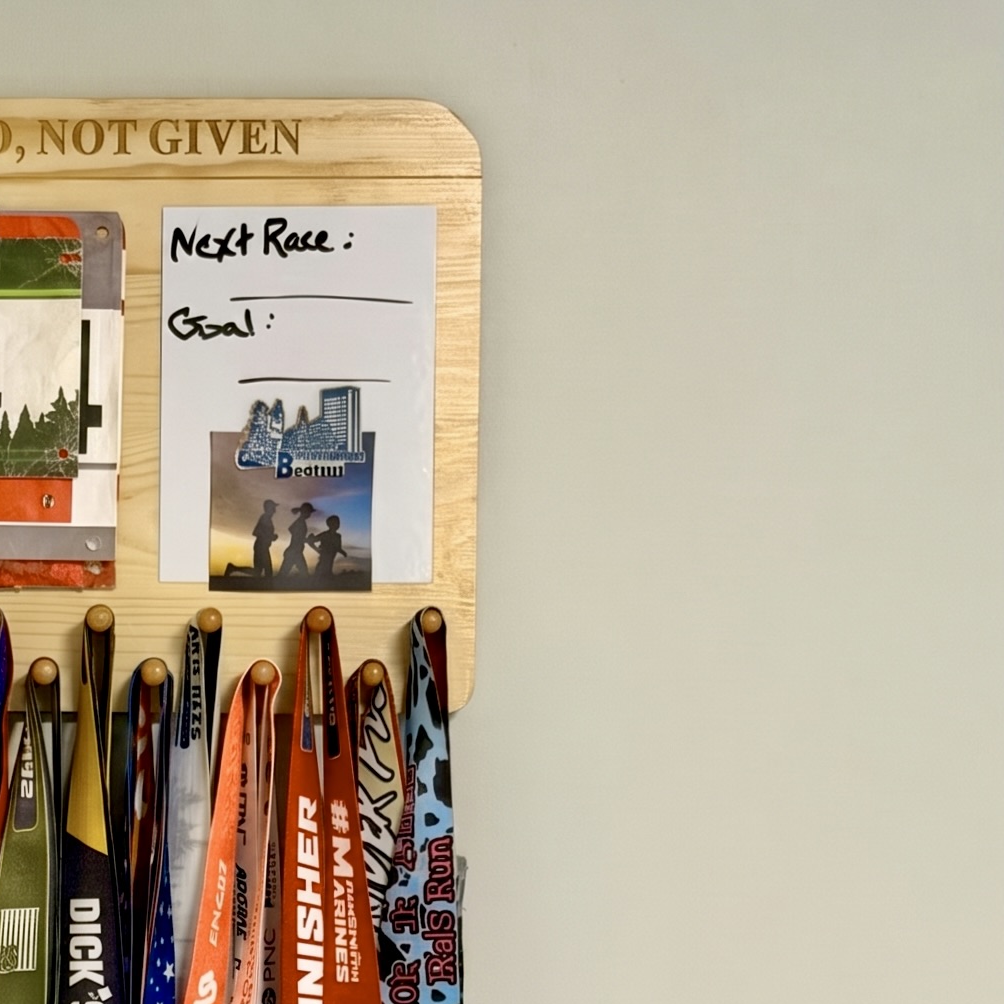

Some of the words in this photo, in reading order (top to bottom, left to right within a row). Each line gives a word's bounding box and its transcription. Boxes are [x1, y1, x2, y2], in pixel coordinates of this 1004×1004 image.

[37, 118, 137, 156] NOT
[149, 118, 302, 156] GIVEN
[170, 222, 254, 263] Next
[262, 927, 277, 983] PNC
